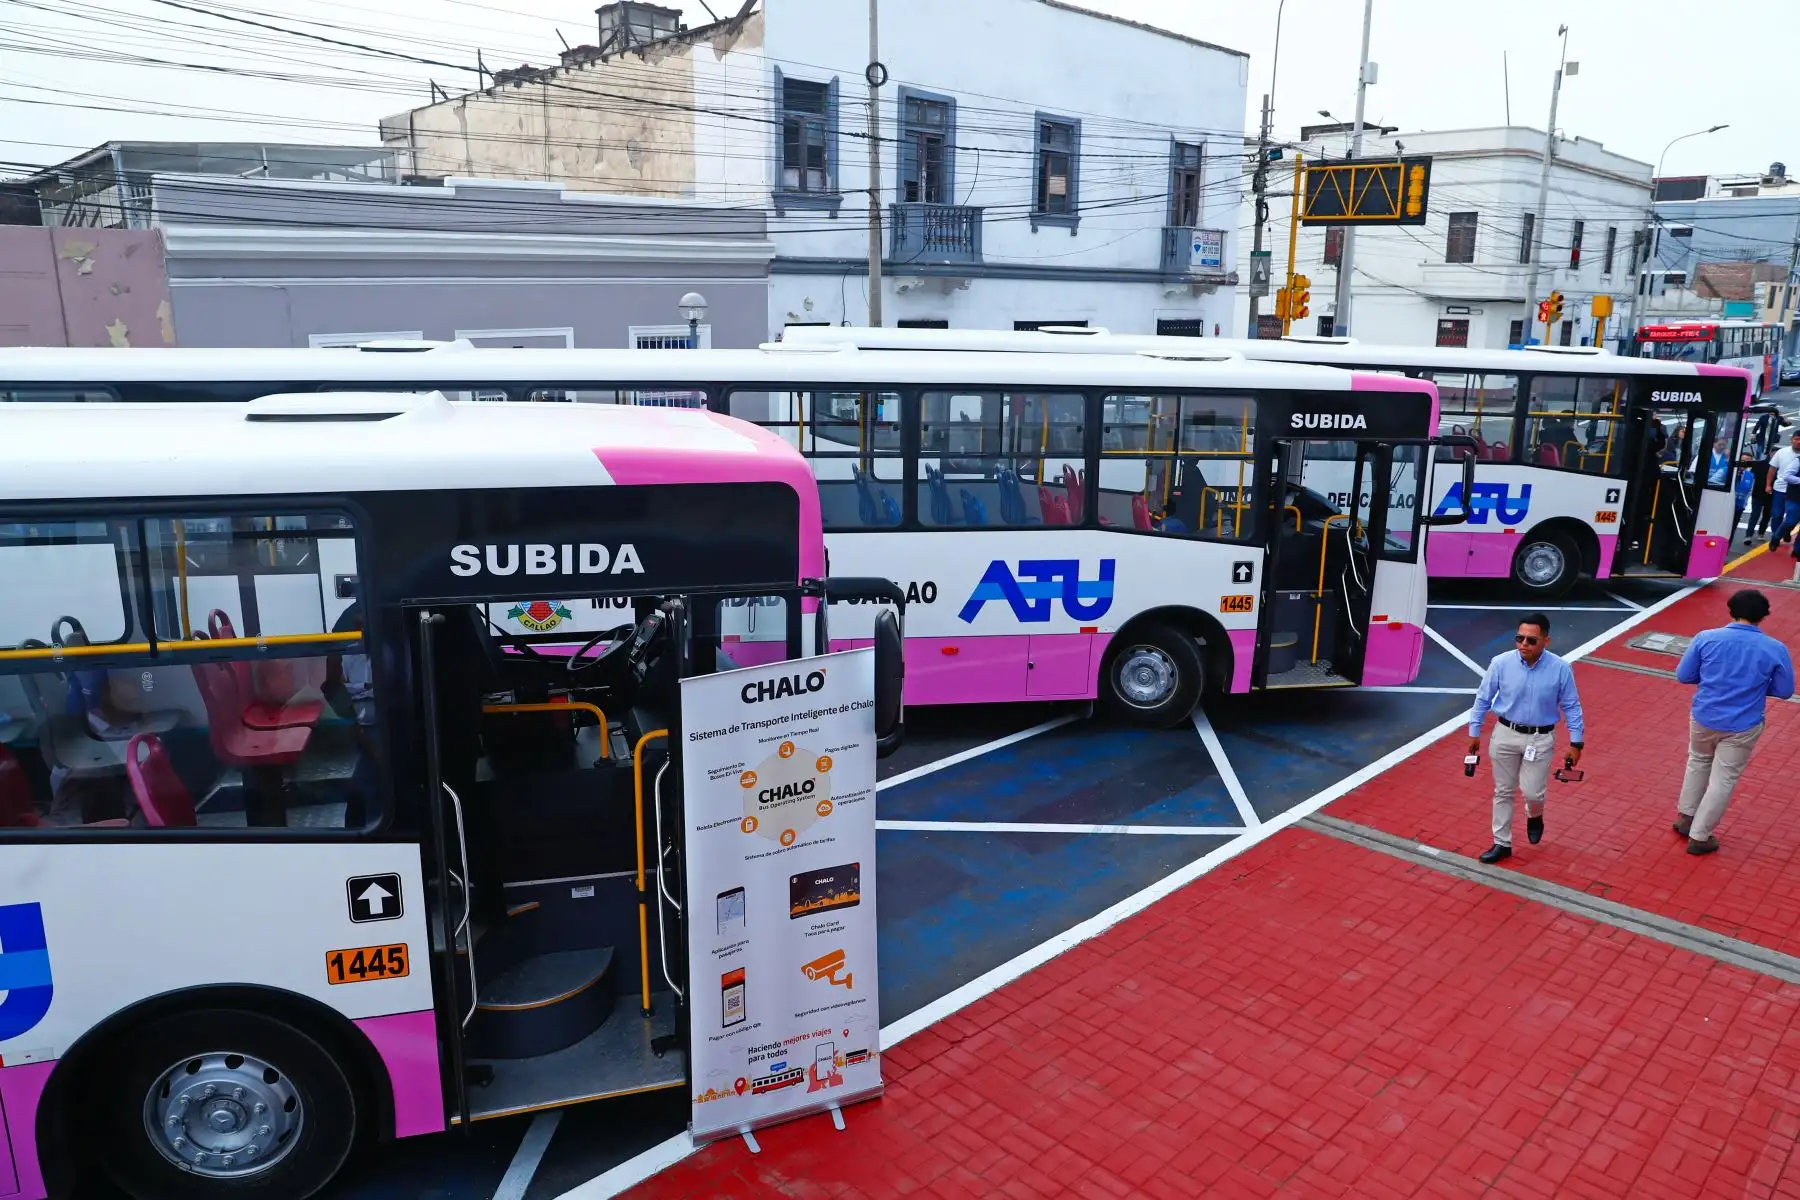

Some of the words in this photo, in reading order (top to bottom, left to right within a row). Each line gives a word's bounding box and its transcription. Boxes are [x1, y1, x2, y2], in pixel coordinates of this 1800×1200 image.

[1651, 391, 1702, 403] SUBIDA
[1291, 413, 1367, 429] SUBIDA
[1432, 482, 1532, 525] ATU
[1596, 512, 1617, 523] 1445
[450, 543, 645, 578] SUBIDA
[958, 559, 1115, 624] ATU
[1222, 596, 1252, 611] 1445
[524, 619, 556, 630] CALLAO
[741, 671, 825, 704] CHALO
[689, 727, 727, 742] Sistema
[729, 724, 740, 734] de
[741, 714, 790, 732] Transporte
[791, 706, 838, 722] Inteligente
[839, 703, 850, 713] de
[851, 698, 874, 713] Chalo
[758, 779, 815, 804] CHALO
[770, 798, 796, 809] Operating
[796, 794, 816, 802] System
[814, 877, 834, 885] CHALO
[331, 947, 405, 981] 1445
[748, 1041, 782, 1055] Haciendo
[783, 1033, 811, 1046] mejores
[811, 1028, 832, 1039] viajes
[748, 1054, 766, 1066] para
[767, 1048, 788, 1060] todos
